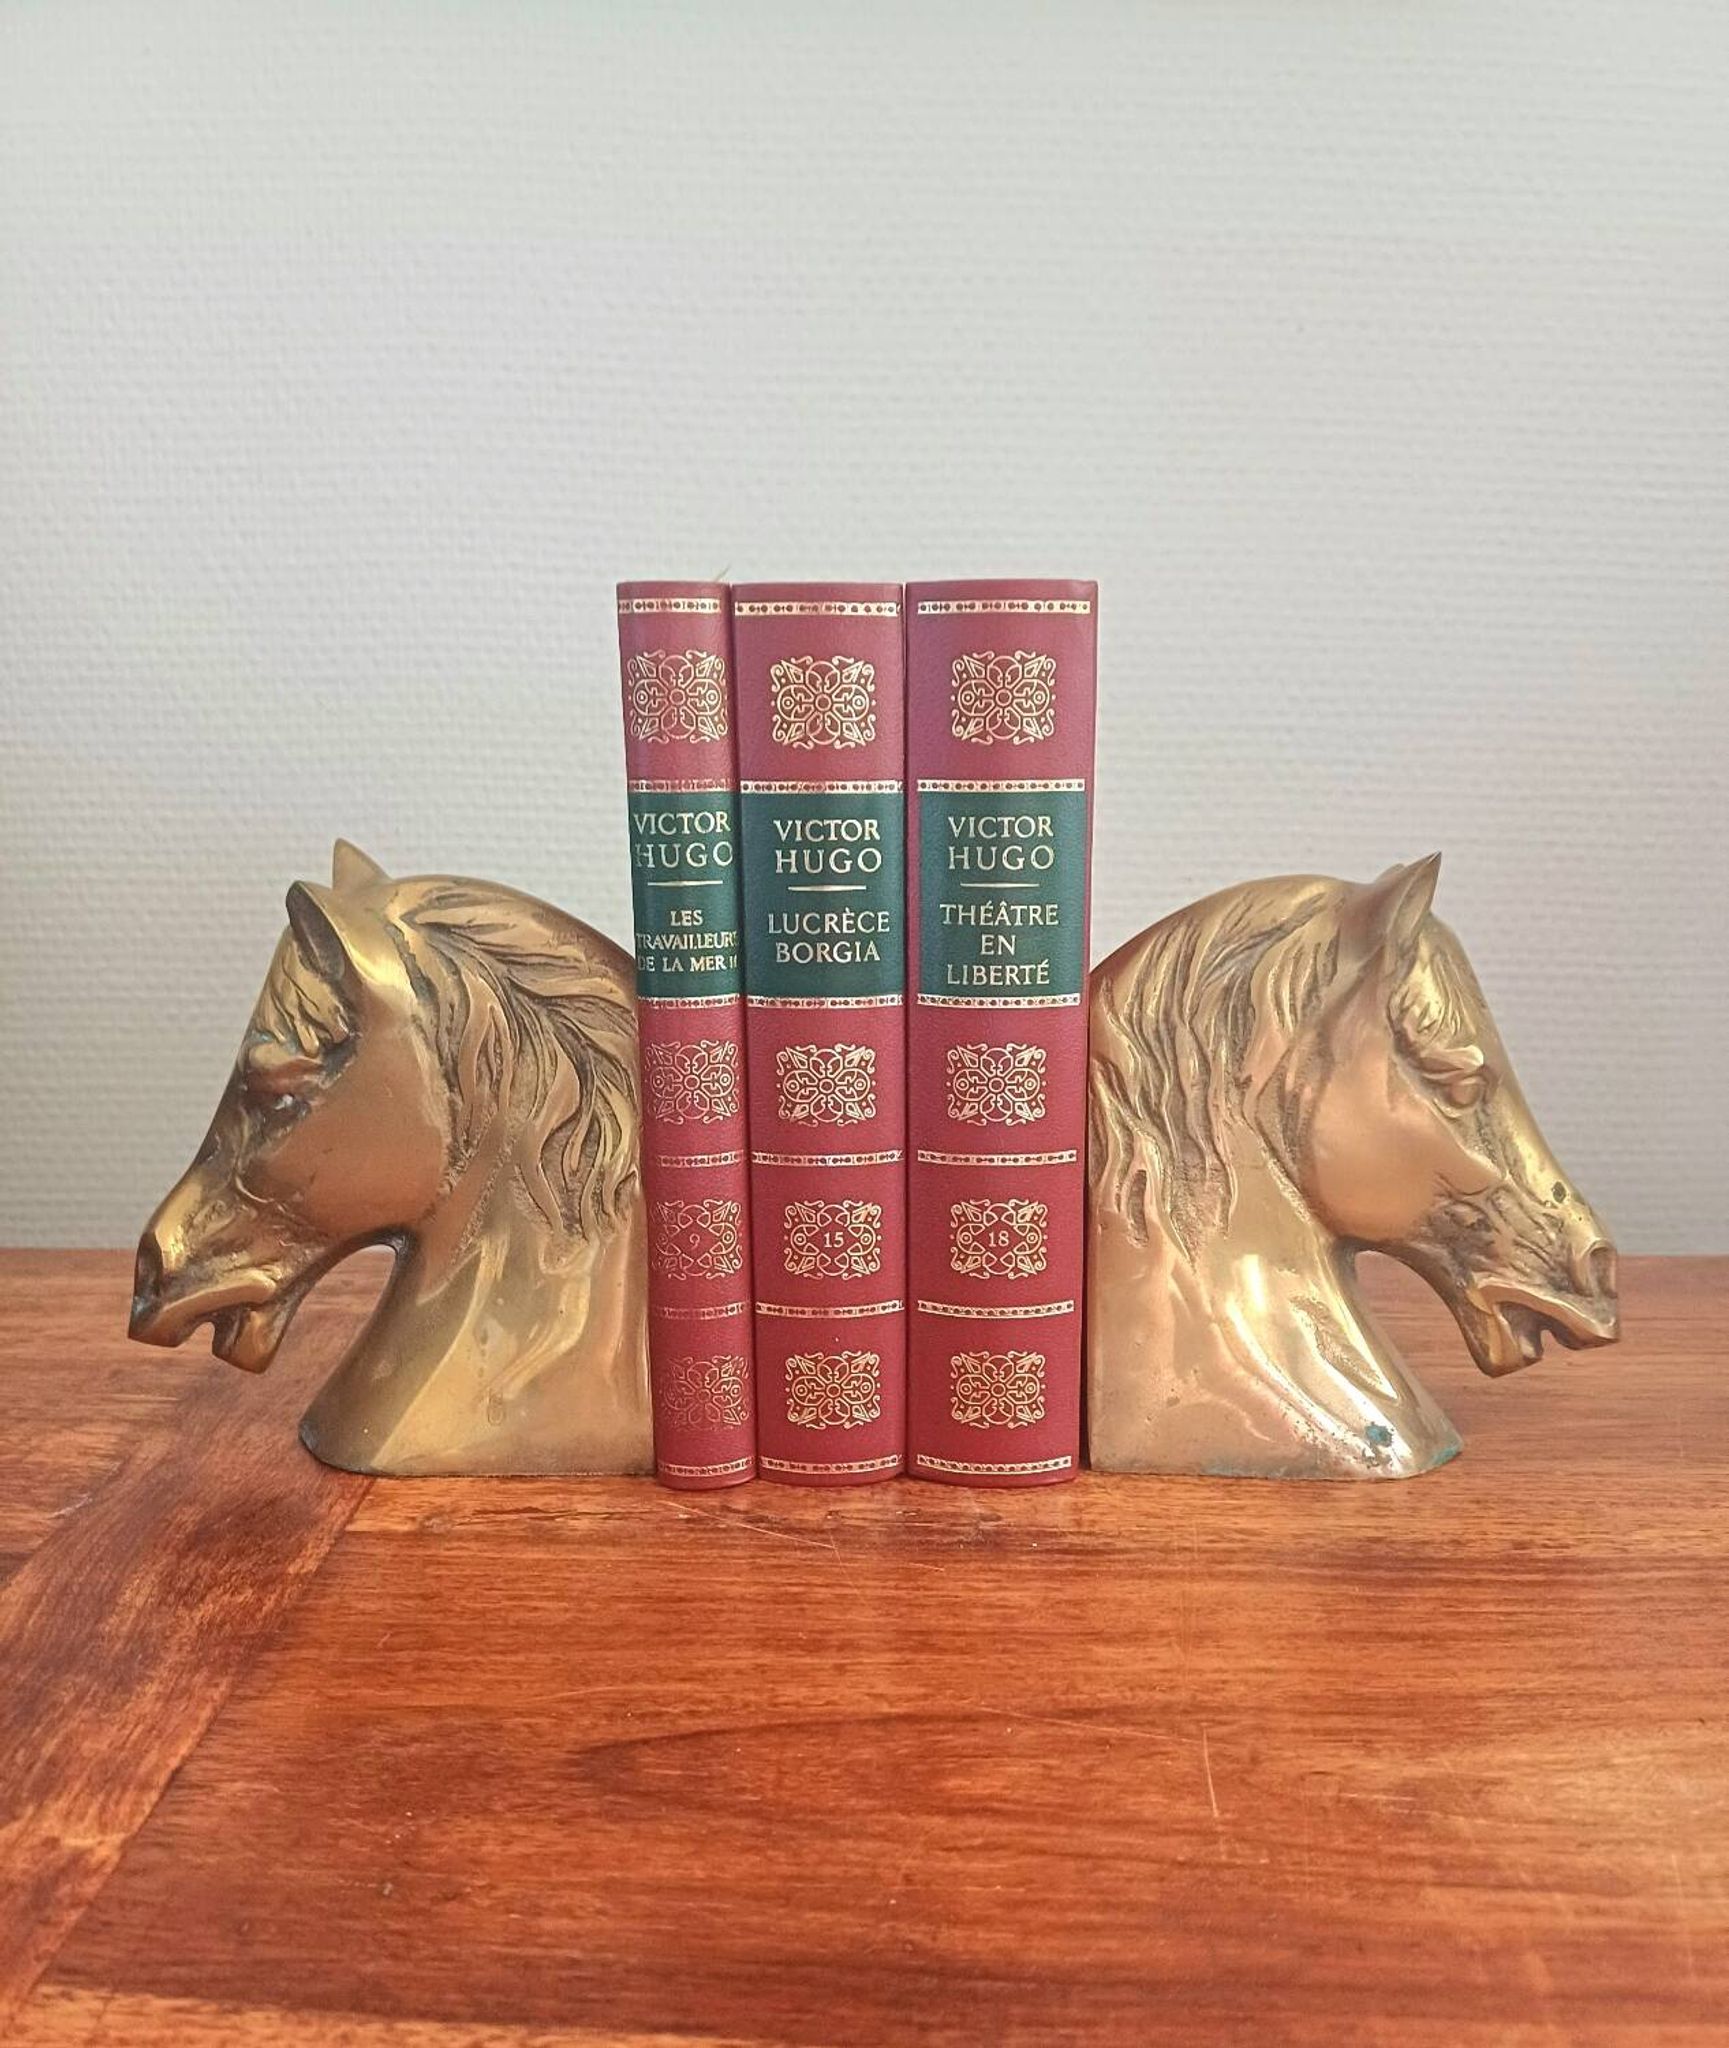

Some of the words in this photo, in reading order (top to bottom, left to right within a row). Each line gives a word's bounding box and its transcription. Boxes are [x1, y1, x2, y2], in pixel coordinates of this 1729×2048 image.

[633, 811, 731, 836] VICTOR
[773, 819, 881, 843] VICTOR
[947, 815, 1054, 840] VICTOR
[635, 841, 733, 869] HUGO
[775, 848, 882, 874] HUGO
[948, 845, 1055, 871] HUGO
[670, 910, 703, 927] LES
[768, 908, 890, 935] LUCRÈCE
[939, 900, 1060, 927] THÉÂTRE
[775, 940, 881, 964] BORGIA
[980, 934, 1017, 956] EN
[637, 956, 655, 972] DE
[662, 957, 684, 972] LA
[689, 955, 727, 972] MER
[947, 959, 1051, 986] LIBERTÉ
[823, 1231, 845, 1248] 15
[988, 1230, 1010, 1247] 18
